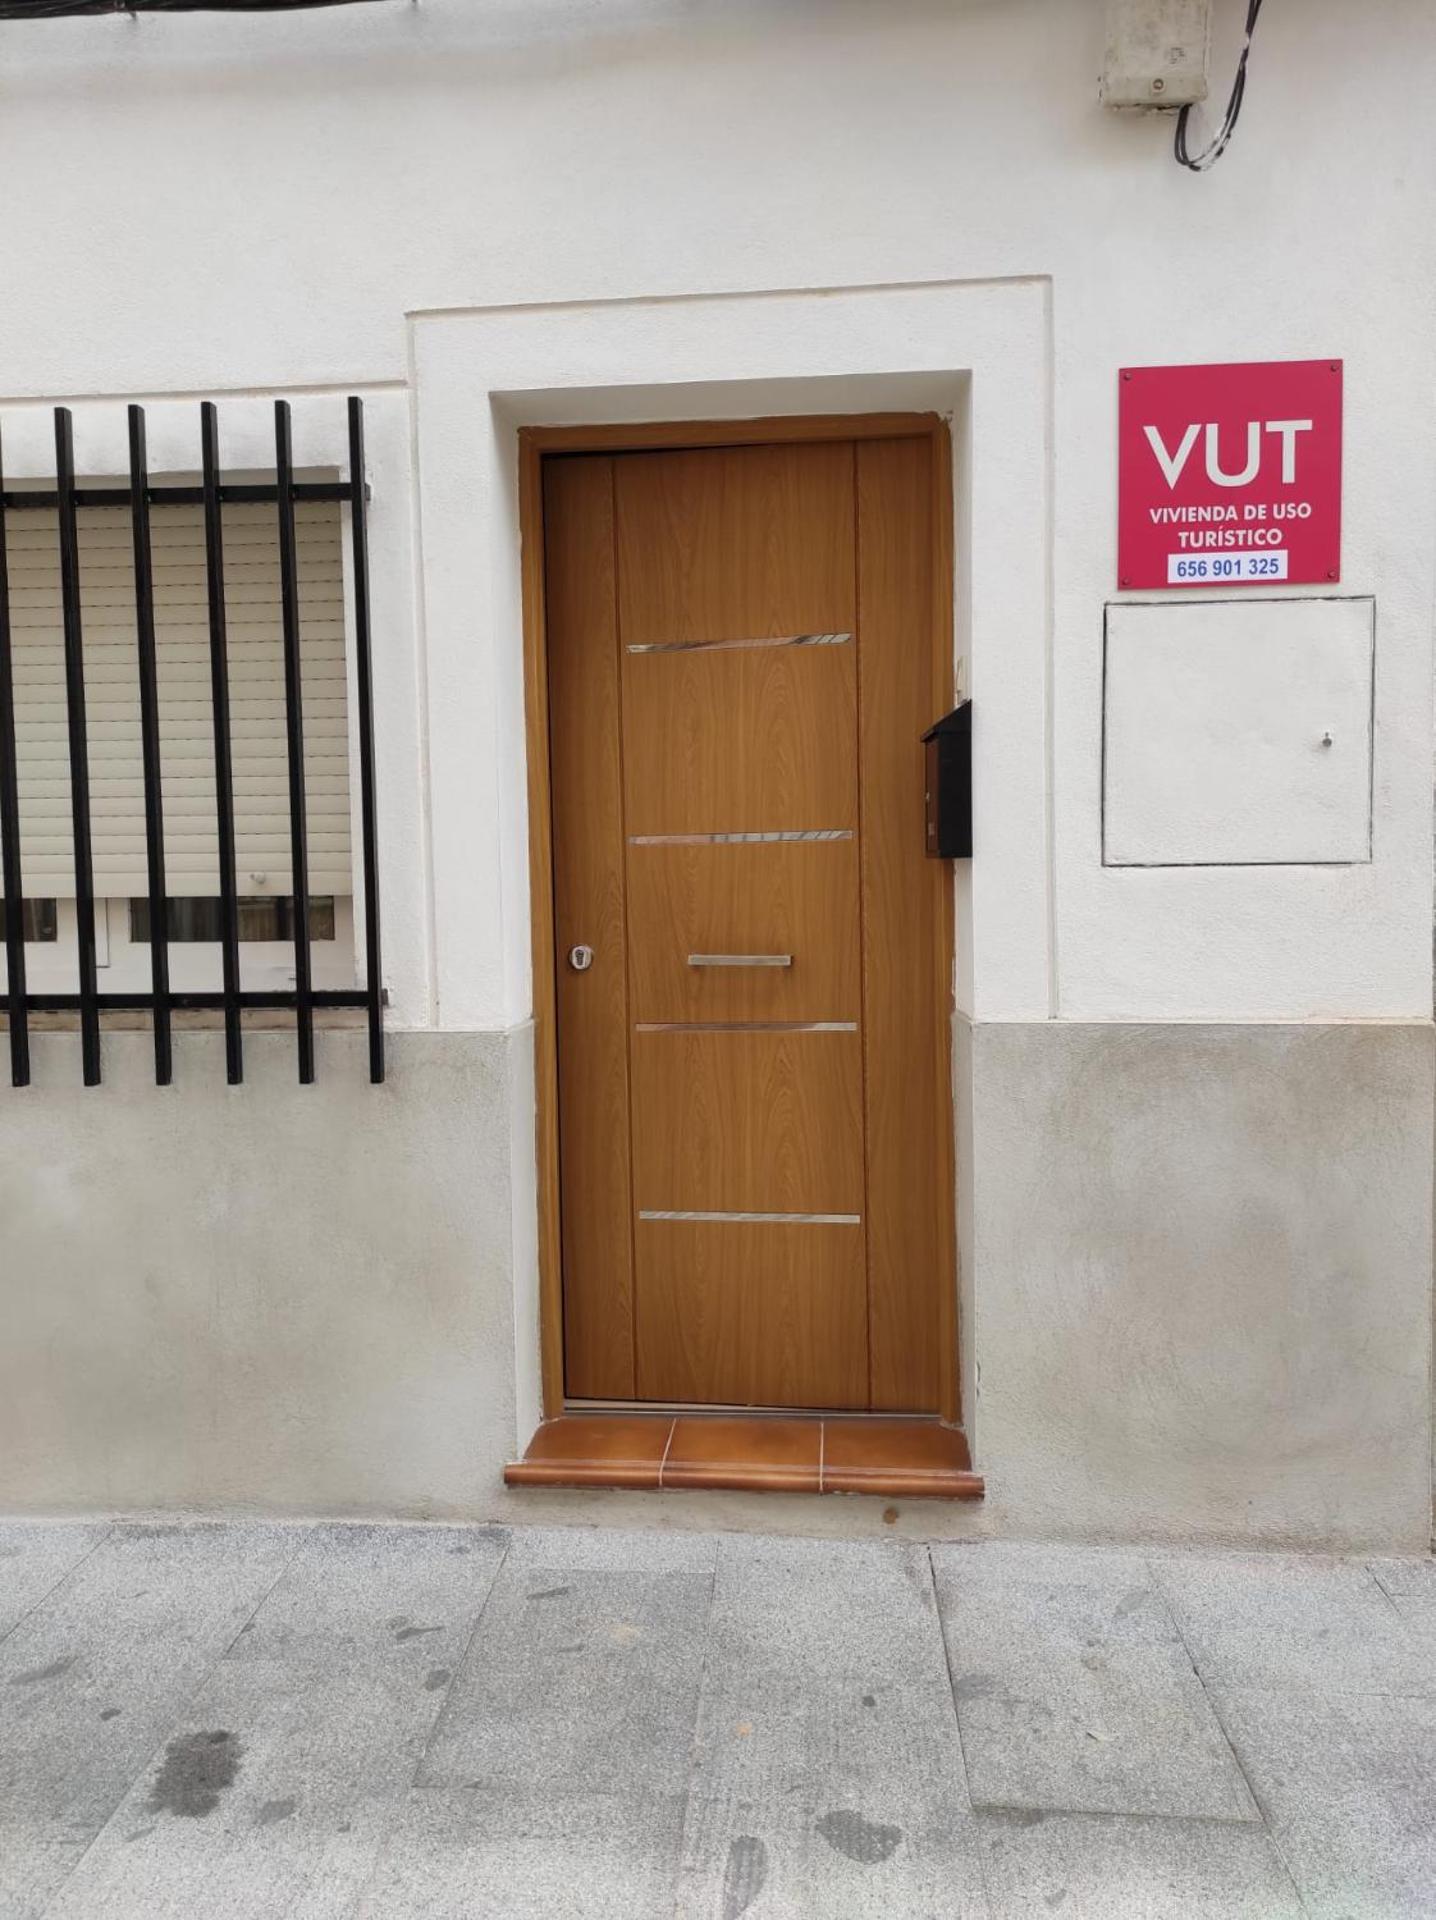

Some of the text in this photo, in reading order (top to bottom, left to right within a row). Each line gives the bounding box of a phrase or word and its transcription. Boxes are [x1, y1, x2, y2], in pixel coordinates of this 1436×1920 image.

[1143, 419, 1313, 490] VUT
[1149, 502, 1312, 524] VIVIENDA DE USO
[1178, 526, 1283, 548] TURÍSTICO
[1176, 557, 1280, 577] 656 901 325
